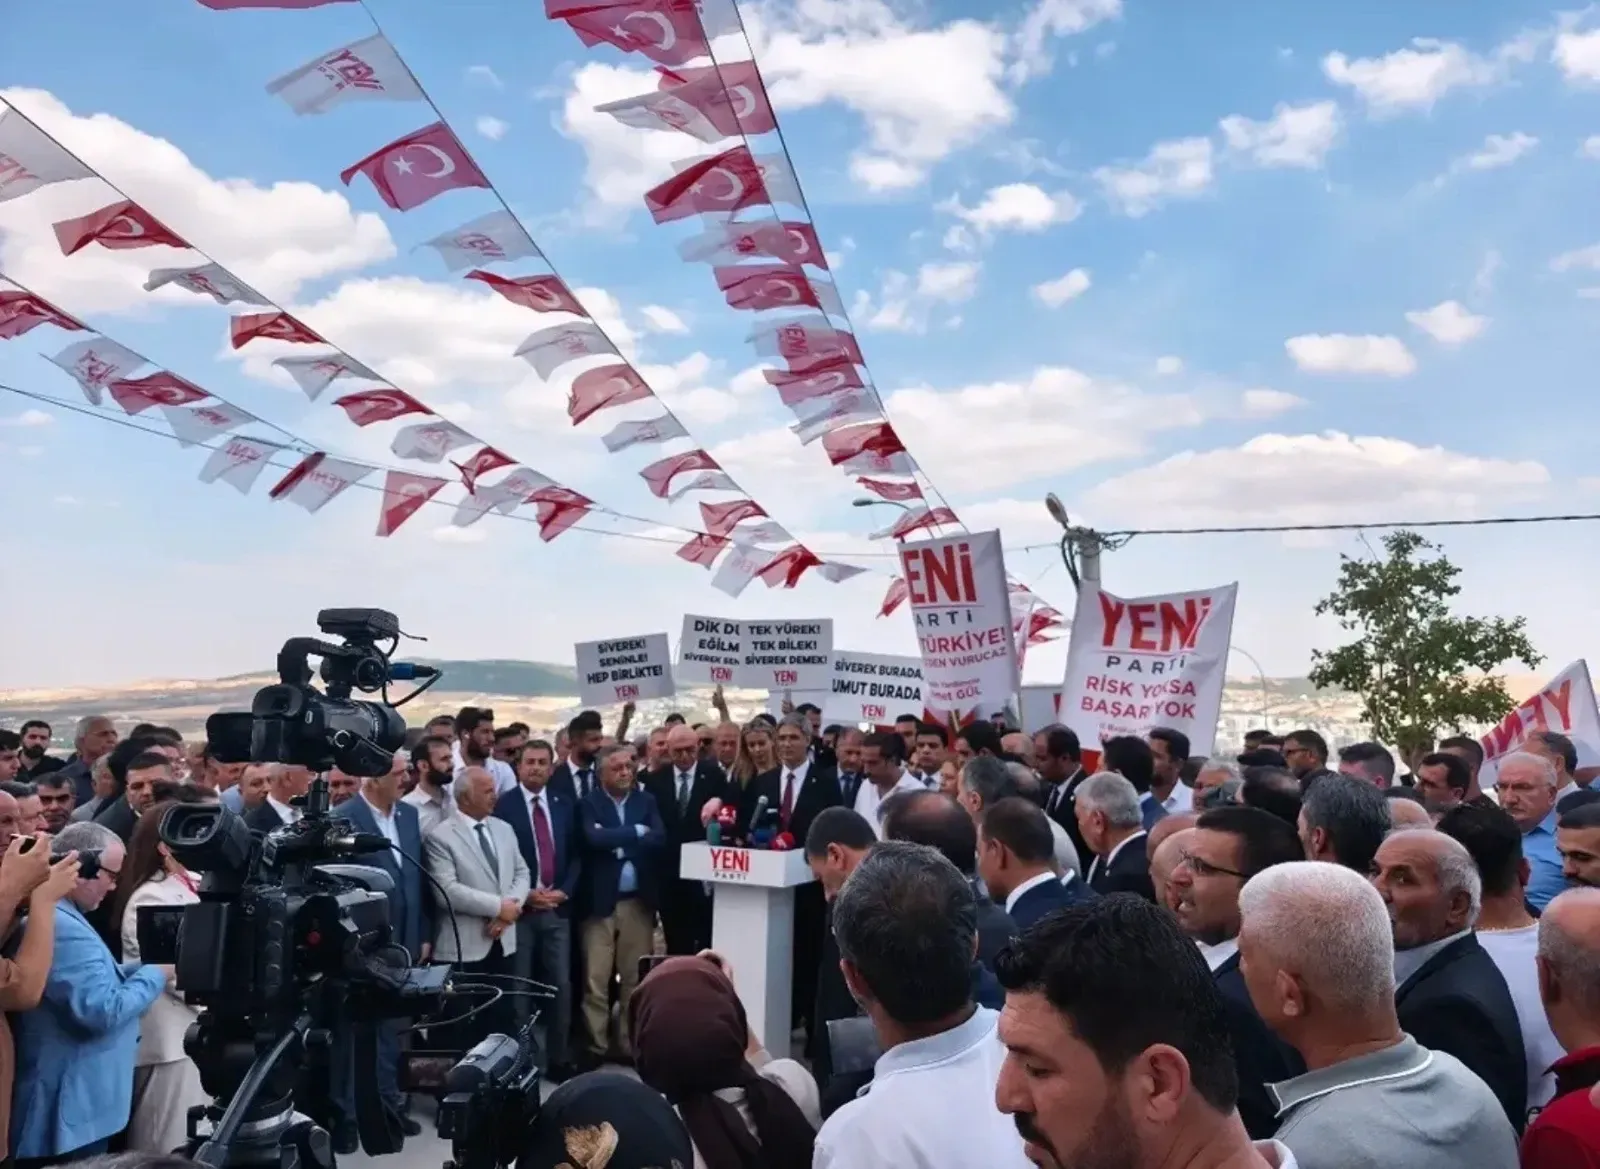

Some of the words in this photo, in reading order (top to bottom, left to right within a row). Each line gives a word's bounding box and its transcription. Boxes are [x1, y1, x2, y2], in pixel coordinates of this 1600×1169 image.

[694, 619, 720, 634] DİK
[748, 625, 772, 635] TEK
[775, 621, 821, 635] YÜREK!
[598, 638, 646, 653] SİVEREK!
[752, 640, 775, 650] TEK
[778, 637, 817, 650] BİLEK!
[919, 627, 1006, 653] TÜRKİYE!
[599, 652, 648, 667] SENİNLE!
[684, 651, 721, 663] SİVEREK
[745, 652, 787, 665] SİVEREK
[789, 655, 828, 665] DEMEK!
[587, 671, 609, 685] HEP
[611, 664, 663, 682] BİRLİKTE!
[834, 658, 877, 674] SİVEREK
[879, 664, 924, 681] BURADA,
[832, 679, 868, 695] UMUT
[869, 682, 922, 701] BURADA
[1086, 674, 1134, 698] RİSK
